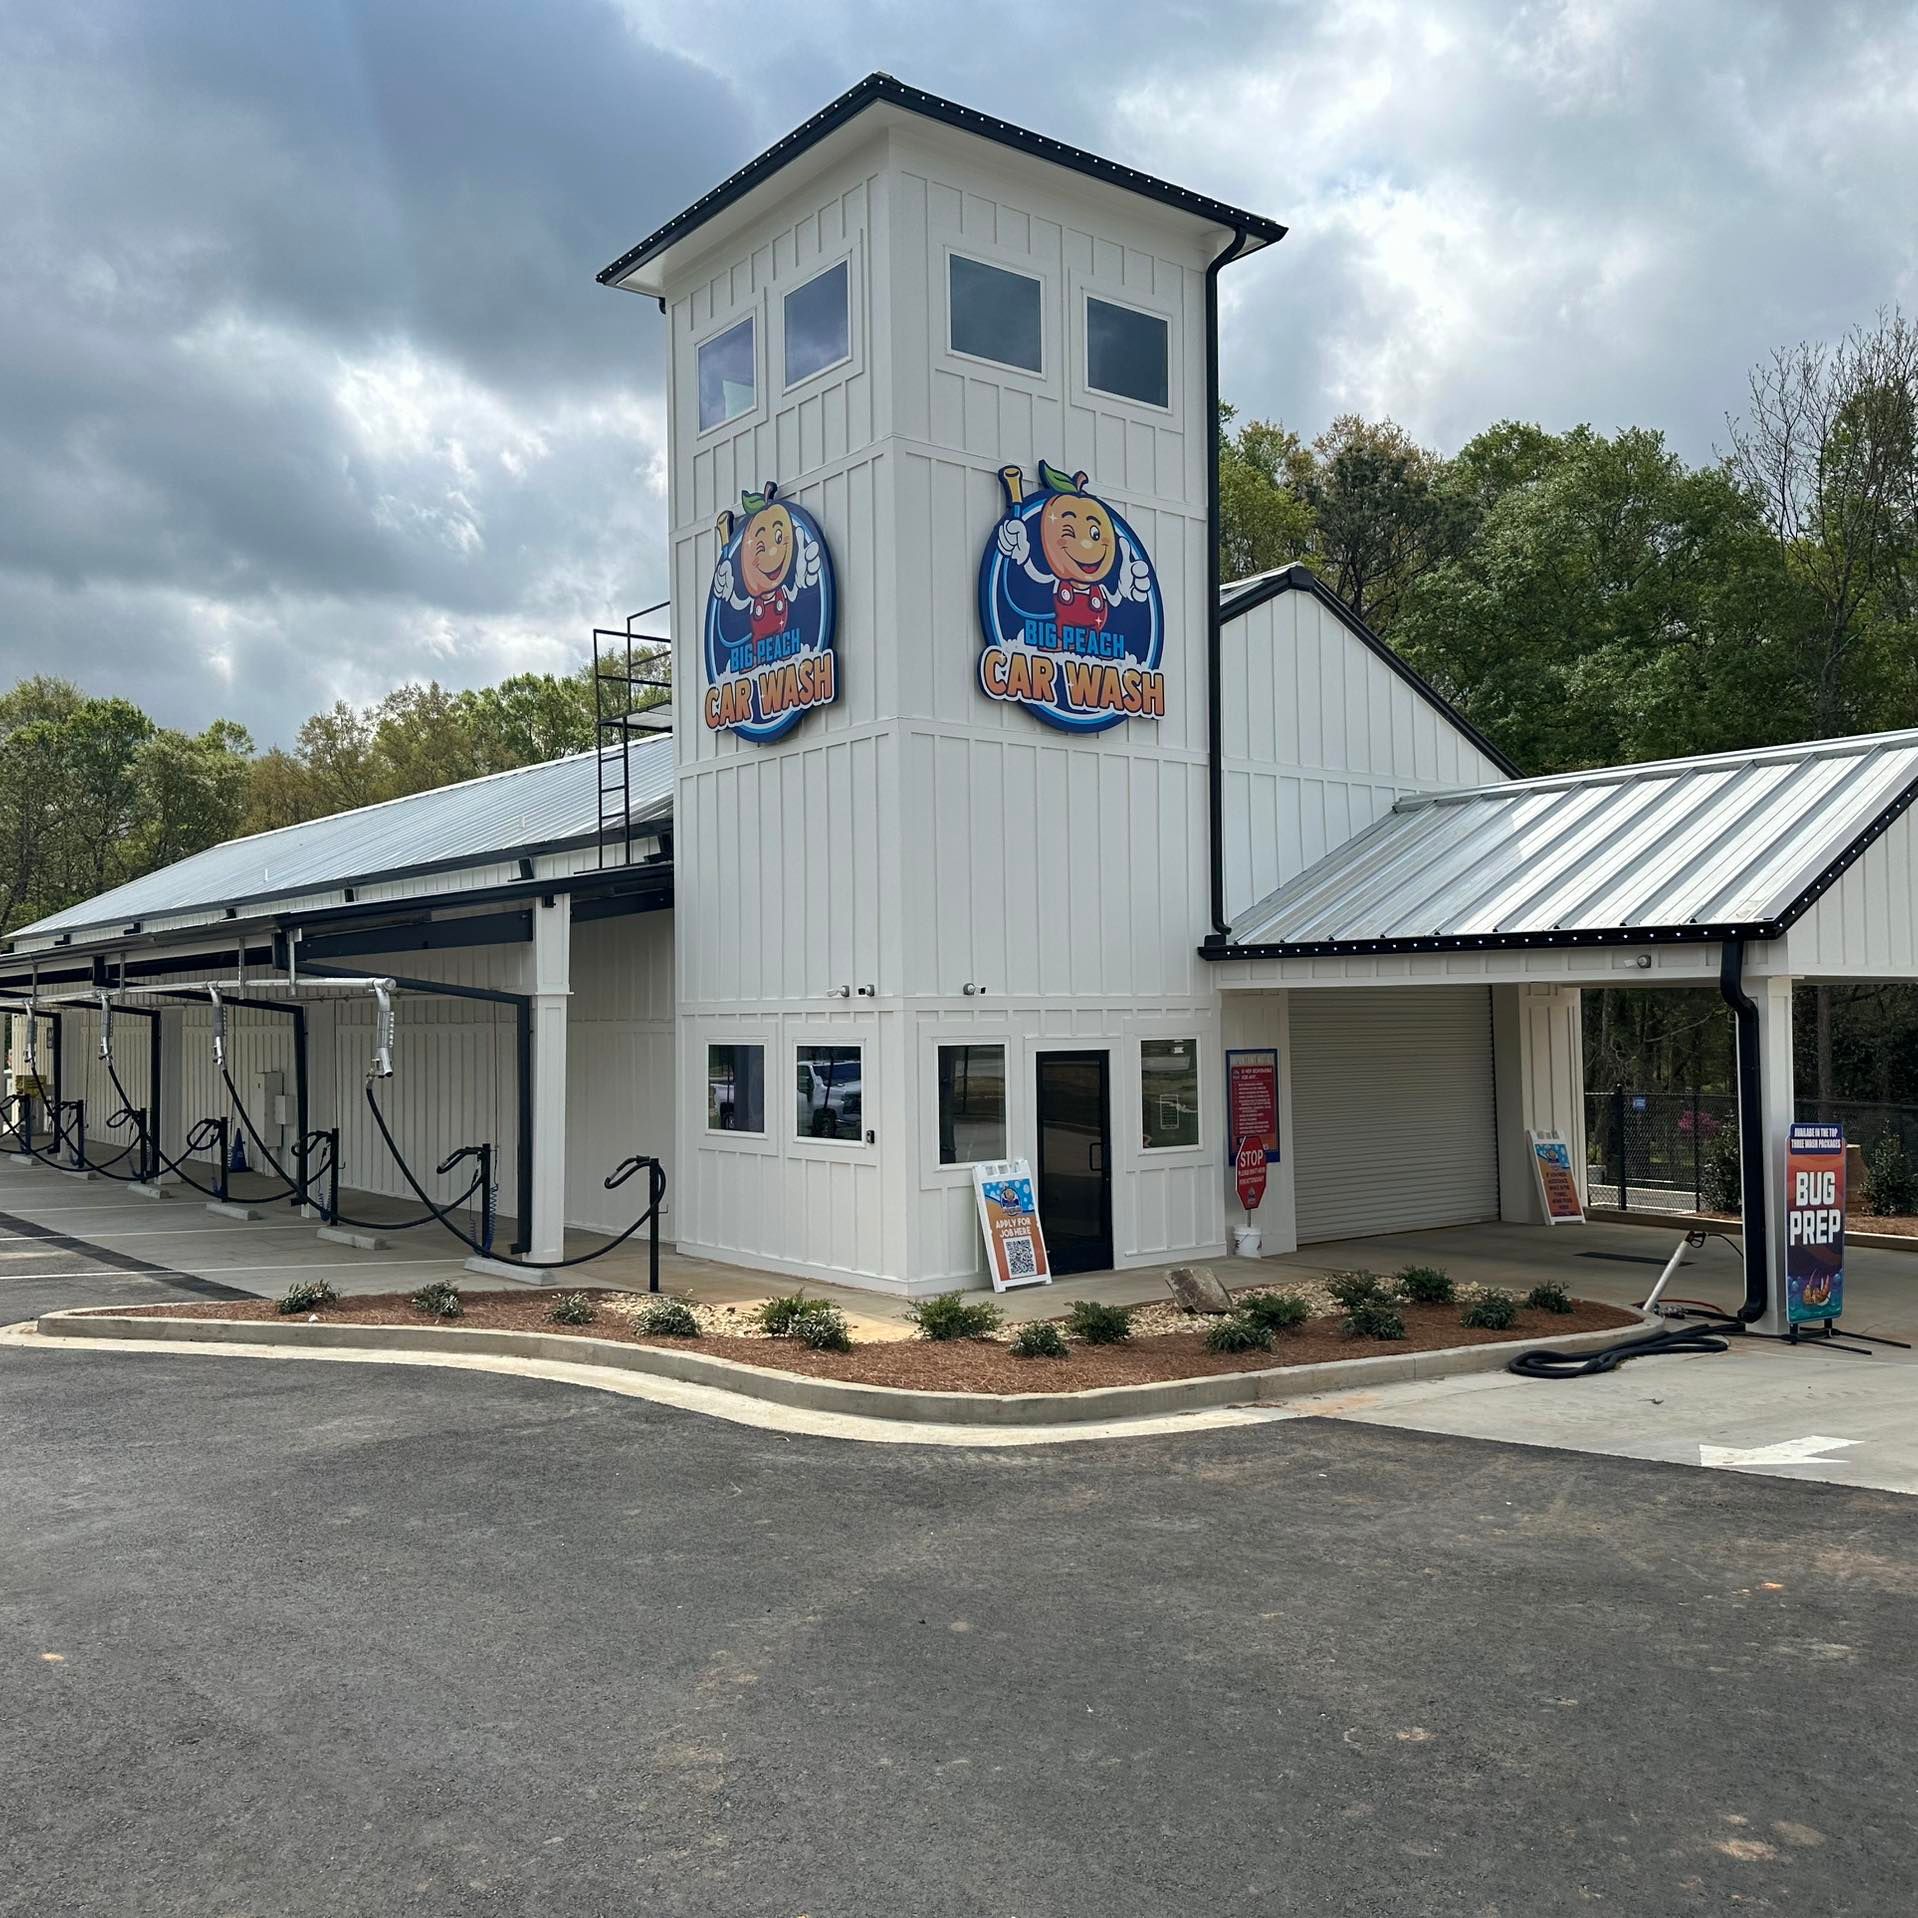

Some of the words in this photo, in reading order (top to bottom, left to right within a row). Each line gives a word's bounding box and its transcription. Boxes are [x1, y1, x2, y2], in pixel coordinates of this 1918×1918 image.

[730, 642, 753, 673] BIG
[757, 628, 801, 662] PEACH
[1024, 619, 1058, 649] BIG
[1062, 625, 1126, 660] PEACH
[705, 677, 752, 729] CAR
[758, 652, 833, 717] WASH
[984, 649, 1056, 702] CAR
[1065, 660, 1166, 717] WASH
[1821, 1127, 1829, 1138] THE
[1829, 1127, 1838, 1137] TOP
[1240, 1149, 1264, 1168] STOP
[1796, 1171, 1836, 1207] BUG
[995, 1219, 1016, 1229] APPLY
[1017, 1217, 1031, 1226] FOR
[999, 1228, 1014, 1238] JOB
[1014, 1227, 1031, 1236] HERE
[1789, 1209, 1841, 1247] PREP
